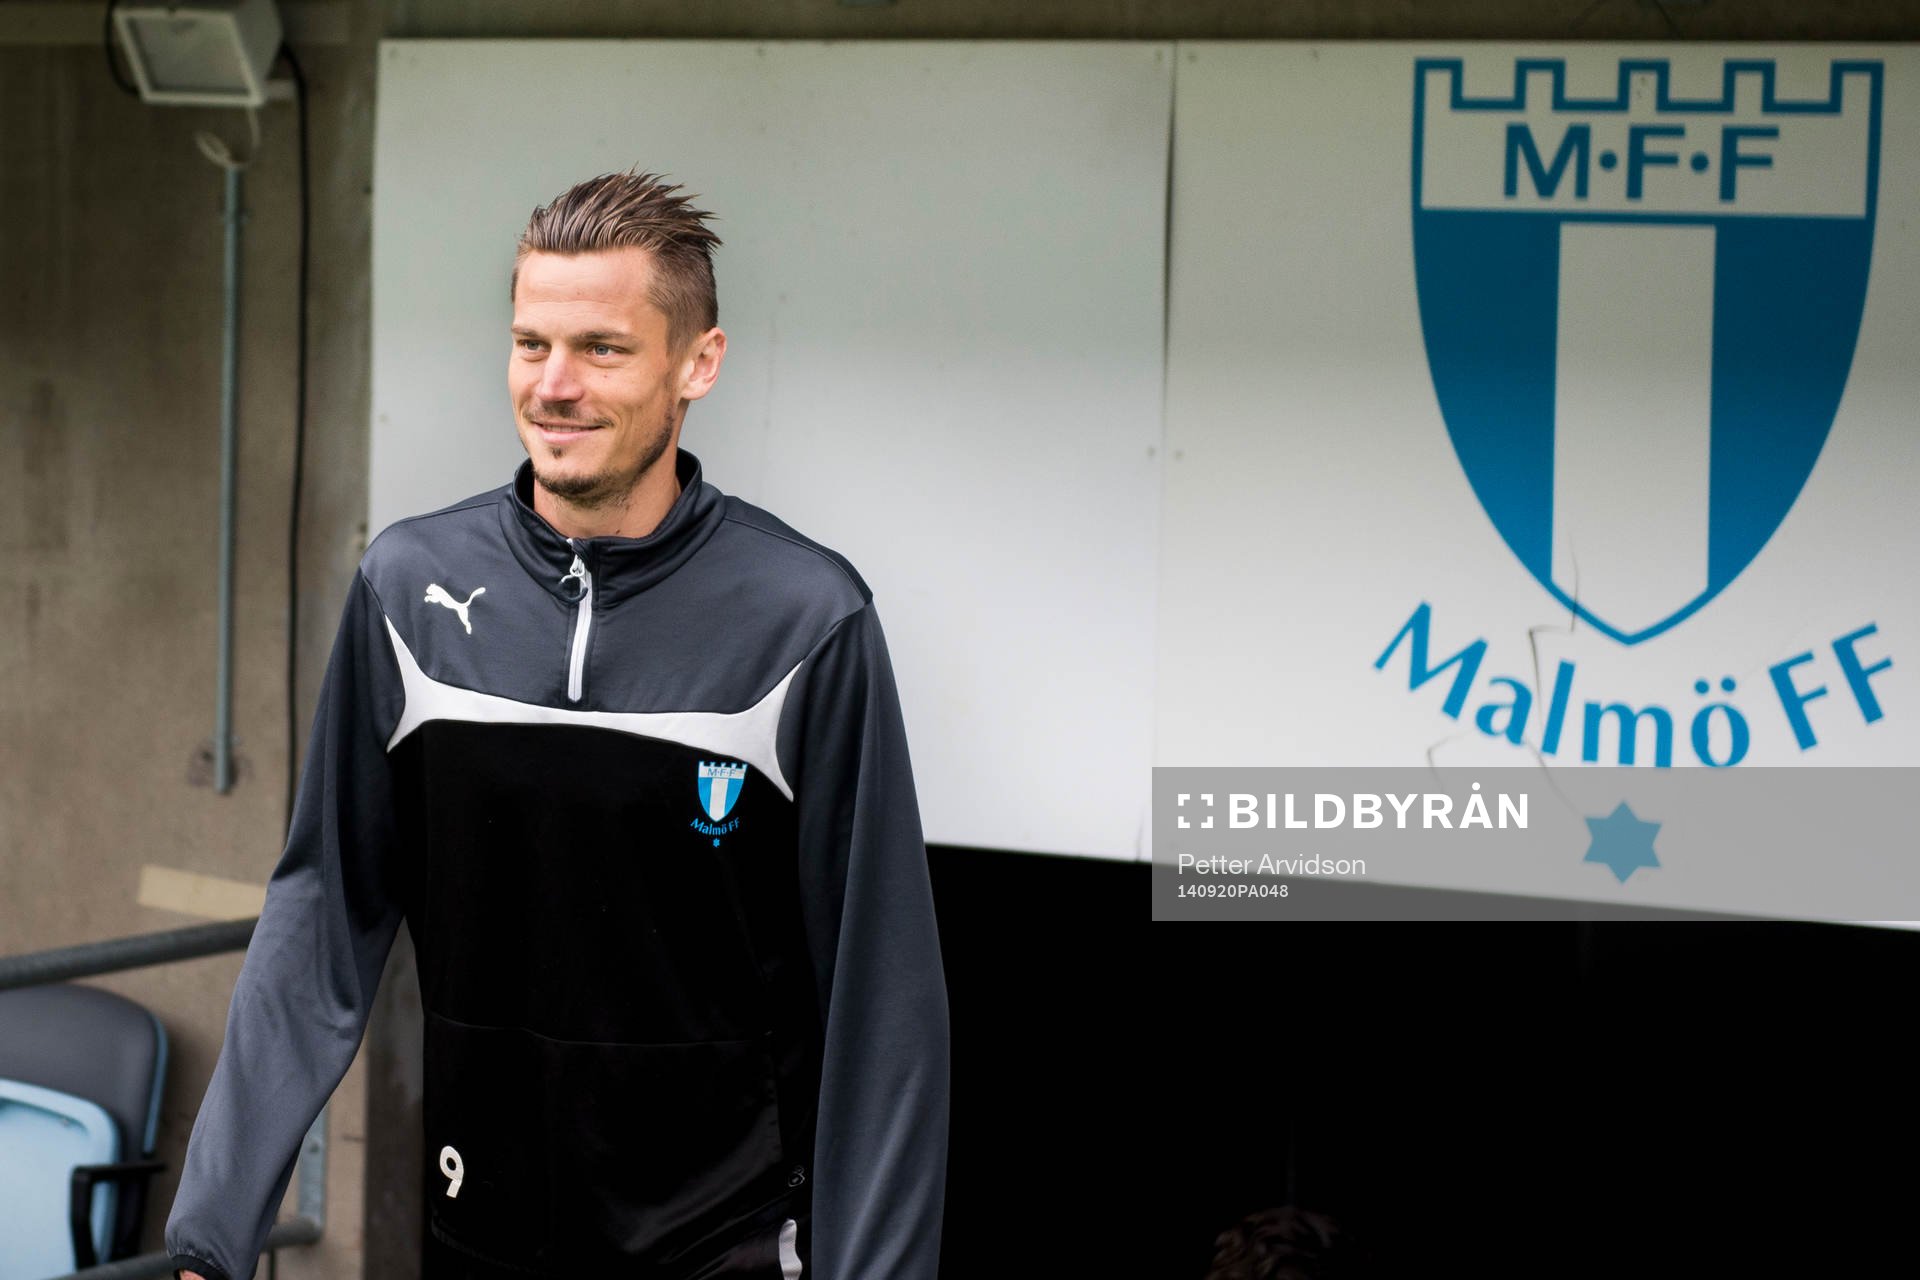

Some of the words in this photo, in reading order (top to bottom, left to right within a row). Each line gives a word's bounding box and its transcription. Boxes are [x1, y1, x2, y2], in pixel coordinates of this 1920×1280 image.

[1373, 600, 1750, 768] Malmö
[1767, 622, 1894, 752] FF
[690, 817, 727, 836] Malmö
[728, 817, 740, 832] FF
[439, 1145, 465, 1198] 9
